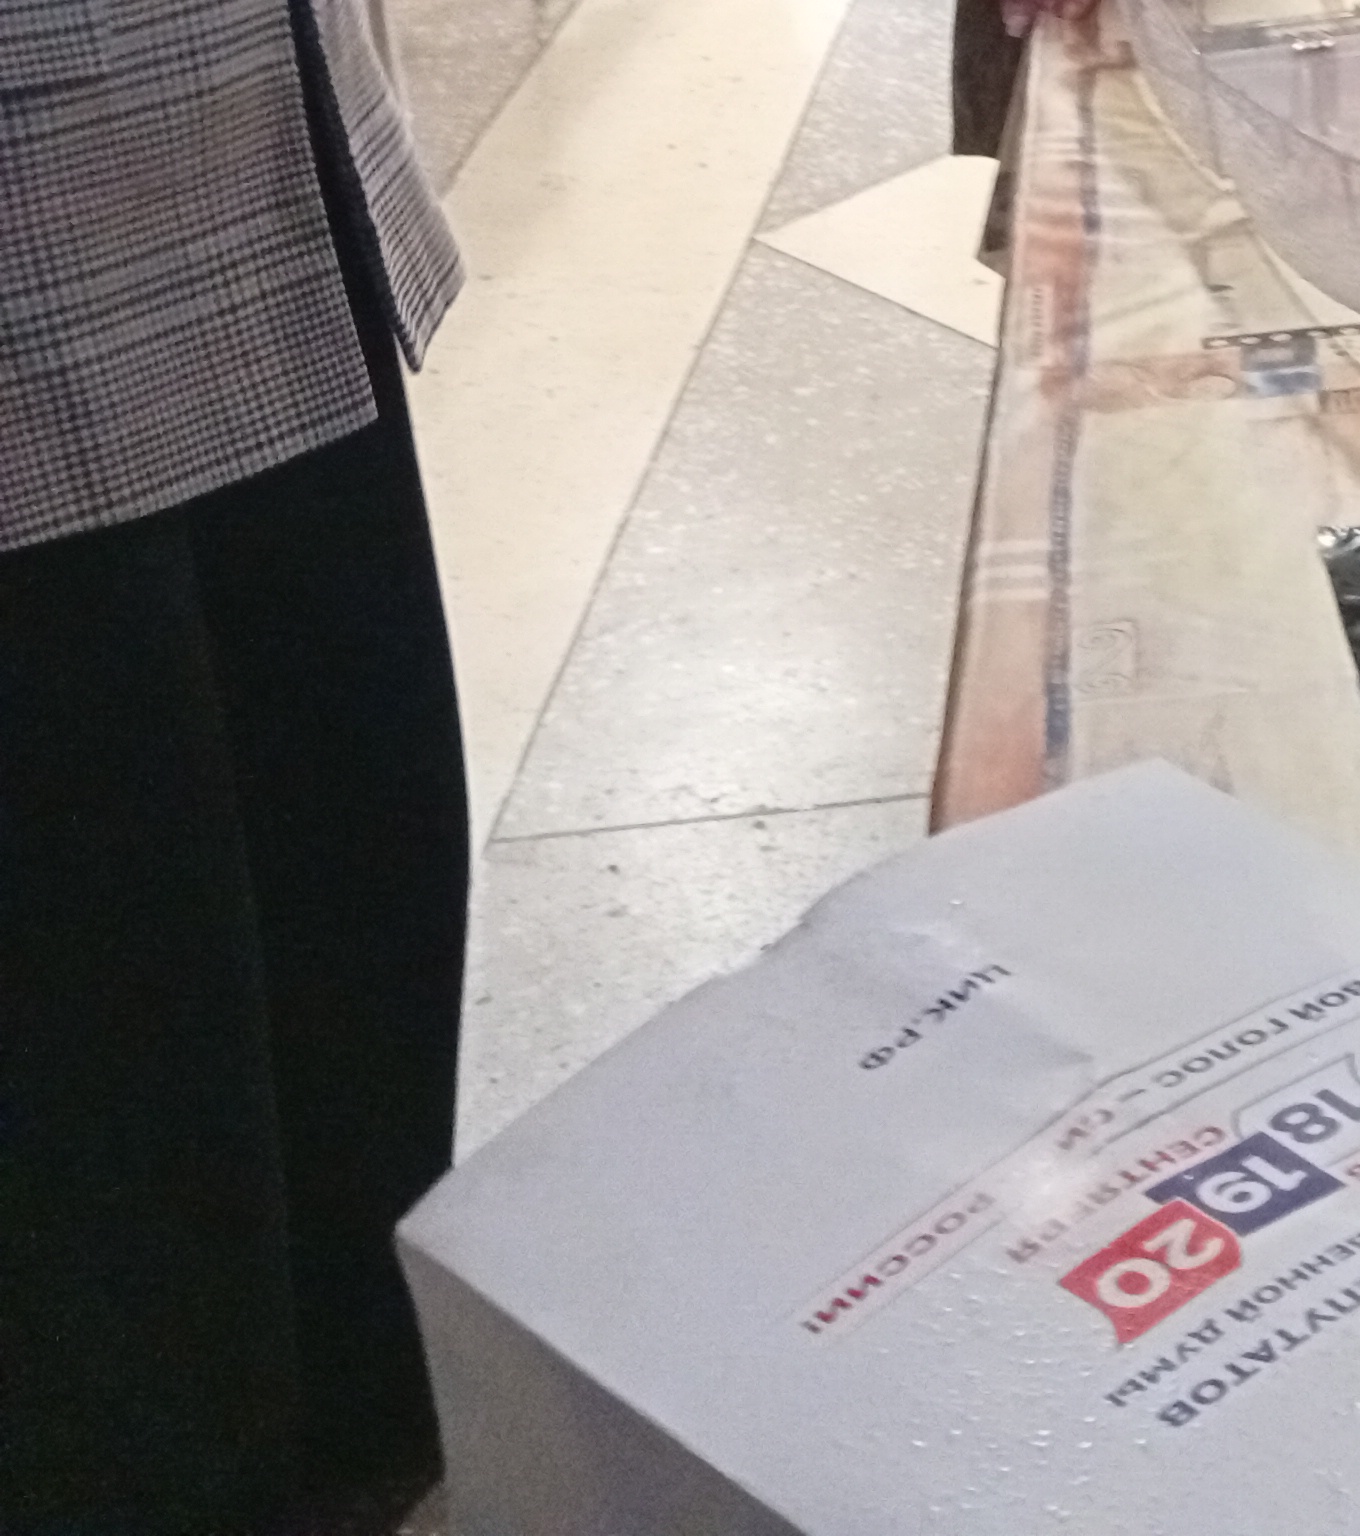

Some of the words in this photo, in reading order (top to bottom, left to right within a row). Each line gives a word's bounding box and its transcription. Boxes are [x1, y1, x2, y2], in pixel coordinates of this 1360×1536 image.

[859, 965, 1011, 1070] ЦИК.РФ
[1154, 1017, 1290, 1088] ГОЛОС
[1195, 1154, 1308, 1214] 19
[802, 1192, 997, 1334] РОССИИ!
[1096, 1217, 1226, 1309] 20
[1103, 1317, 1225, 1408] ДУМЫ
